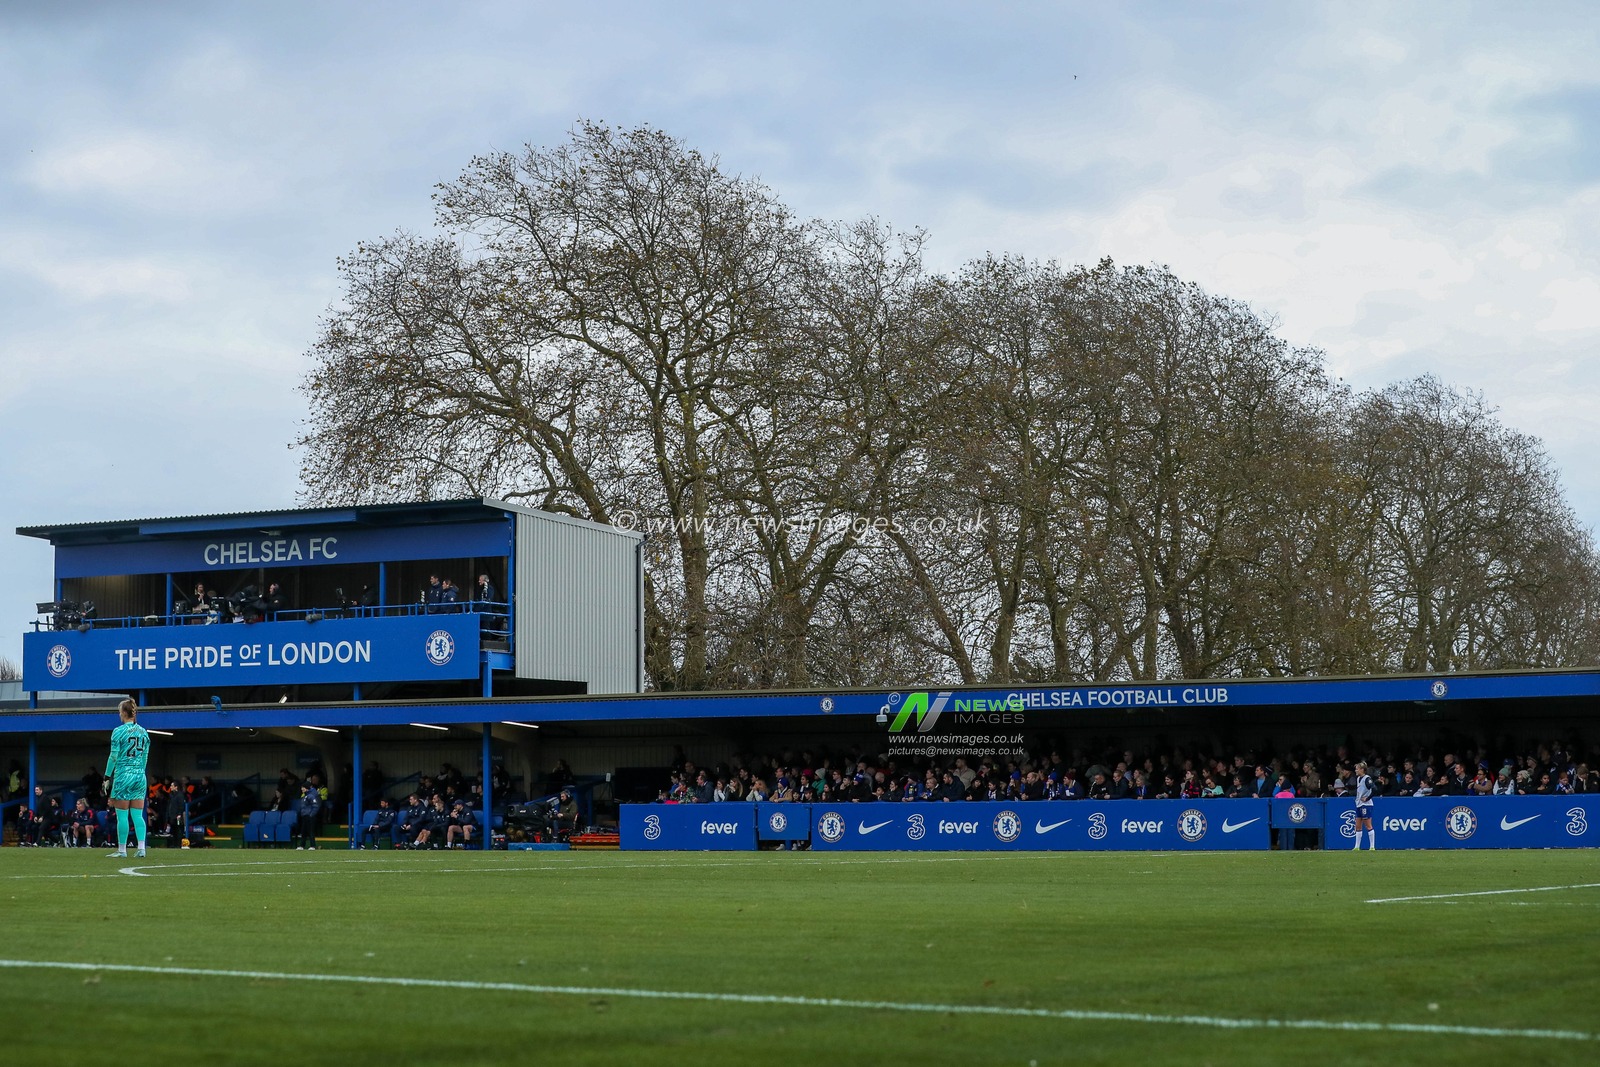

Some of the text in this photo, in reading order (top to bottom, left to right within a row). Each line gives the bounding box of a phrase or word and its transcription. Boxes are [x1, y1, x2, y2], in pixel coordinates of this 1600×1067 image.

[204, 537, 338, 565] CHELSEA FC
[115, 640, 371, 670] THE PRIDE OF LONDON
[1007, 688, 1228, 708] CHELSEA FOOTBALL CLUB
[127, 736, 144, 757] 24
[701, 820, 738, 834] fever
[939, 820, 978, 834] fever
[1121, 818, 1163, 833] fever
[1382, 815, 1427, 831] fever
